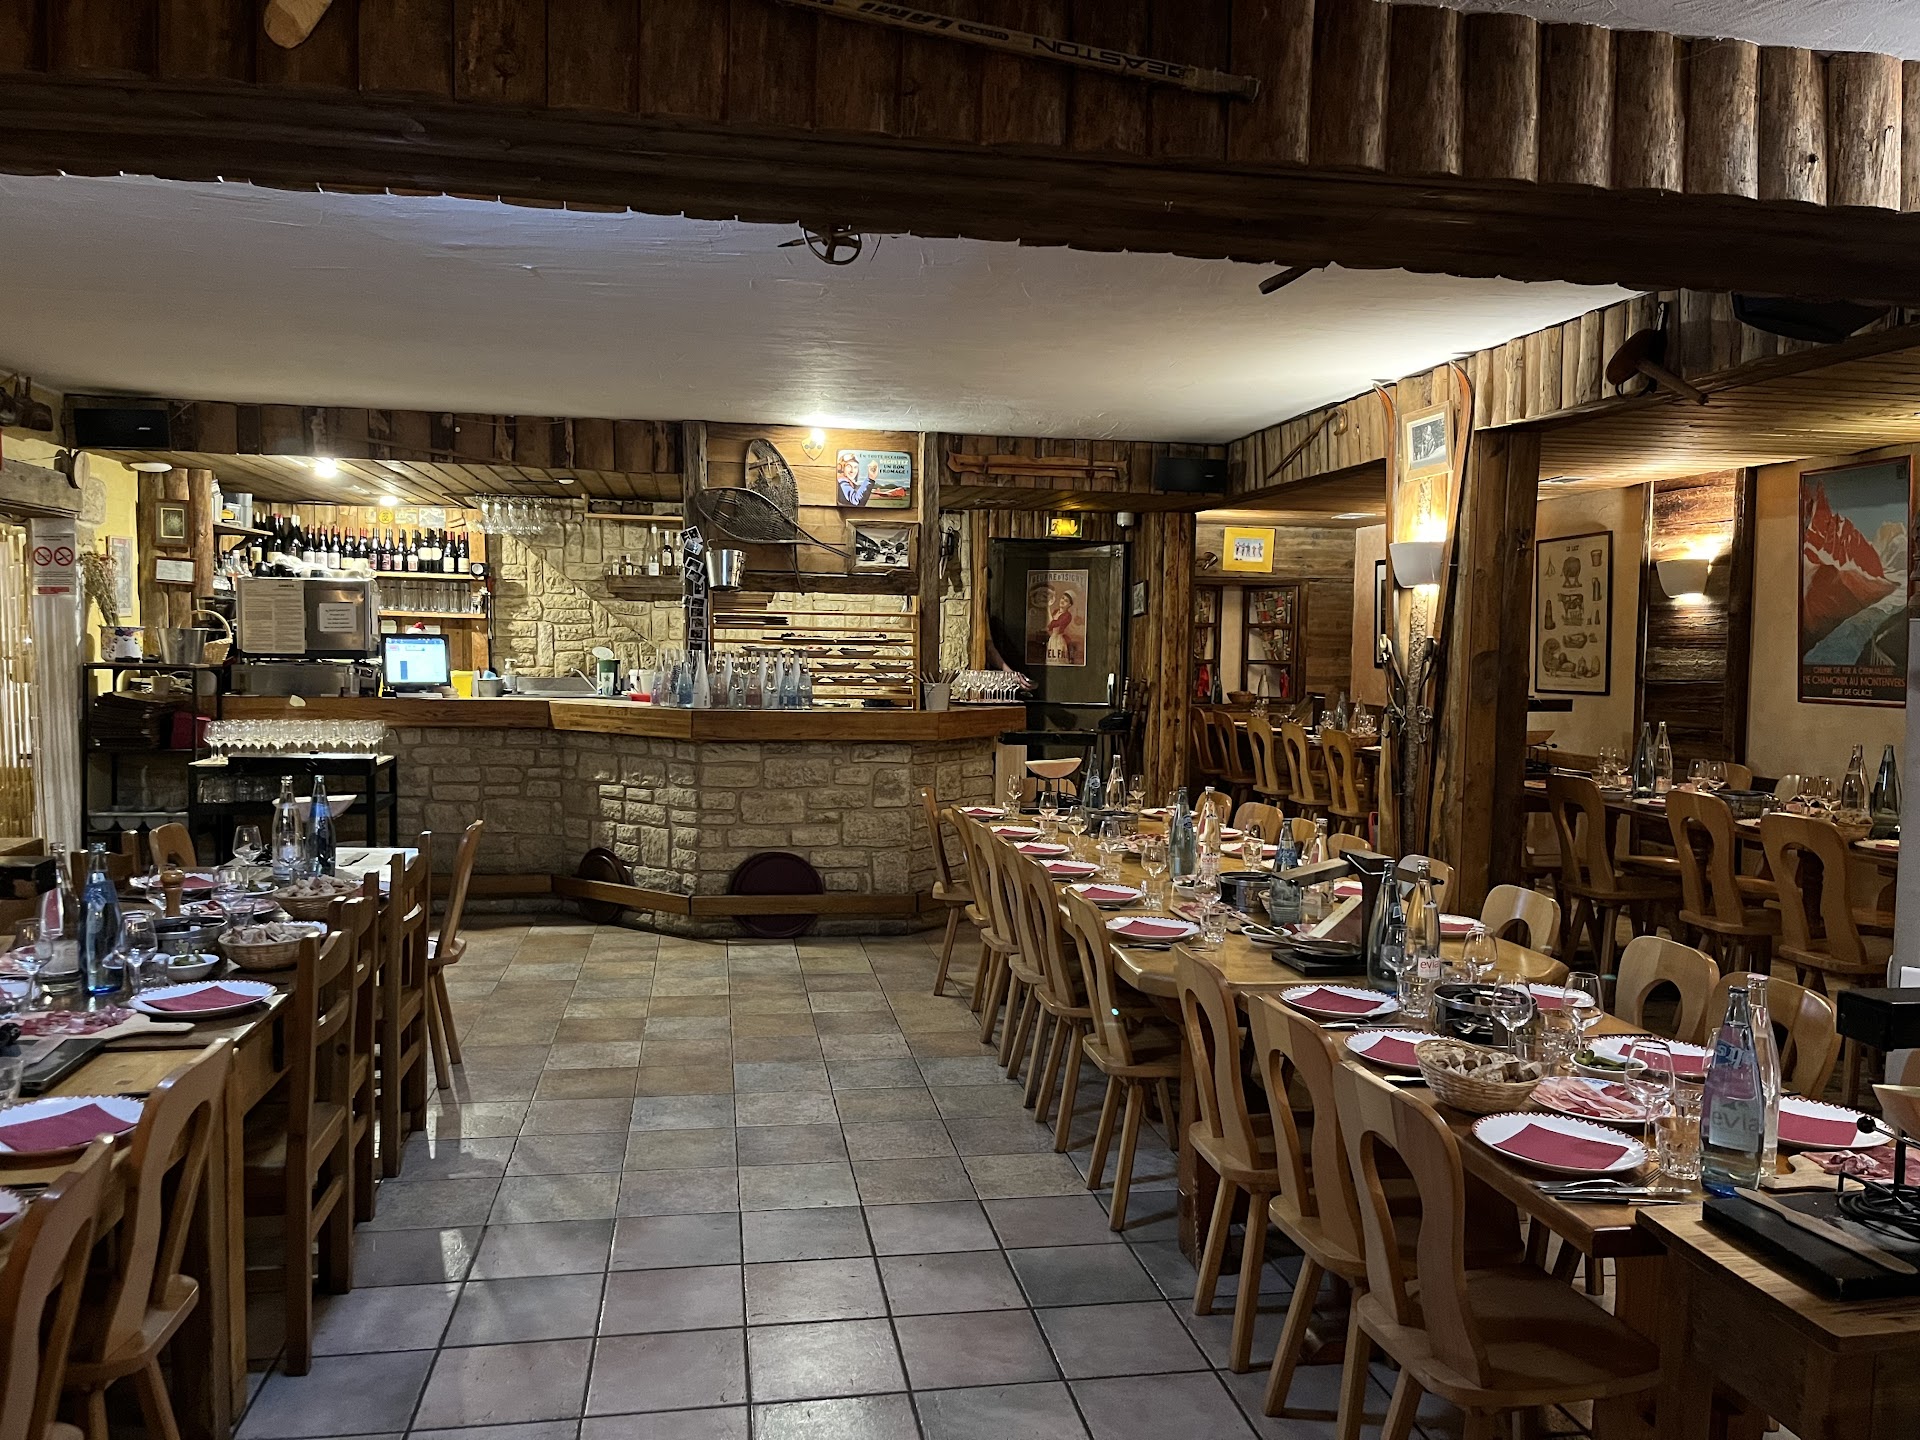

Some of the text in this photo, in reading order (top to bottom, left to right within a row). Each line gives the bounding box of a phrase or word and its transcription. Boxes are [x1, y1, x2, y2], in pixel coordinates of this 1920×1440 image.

[1033, 37, 1167, 74] EASTON
[1803, 675, 1811, 685] DE
[1812, 675, 1848, 686] CHAMONIX
[1849, 676, 1858, 686] AU
[1844, 688, 1852, 696] DE
[1852, 688, 1873, 697] GLACE
[1712, 1110, 1760, 1132] evia
